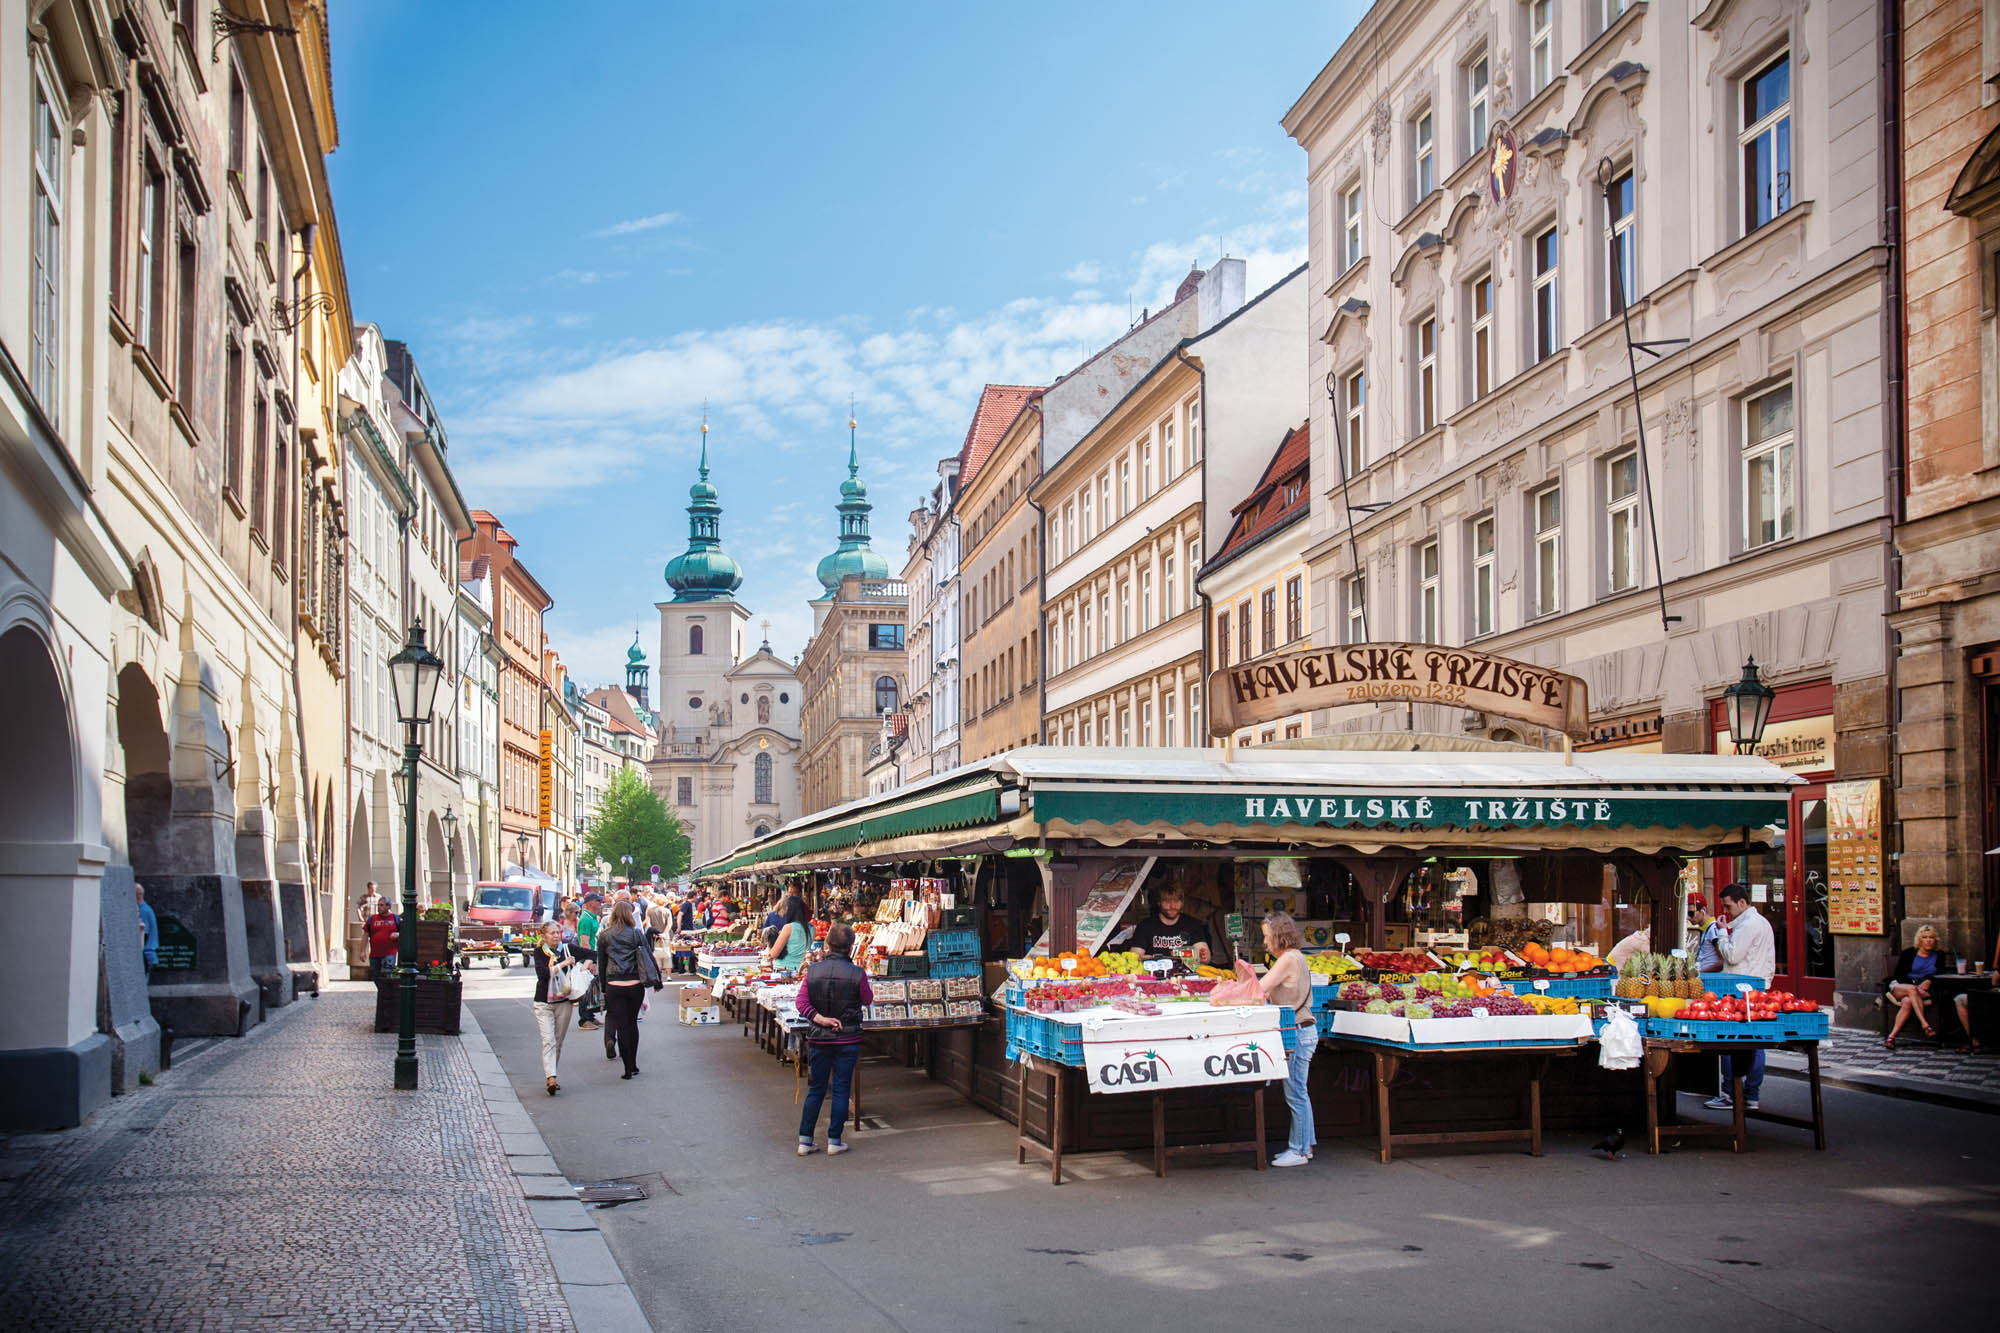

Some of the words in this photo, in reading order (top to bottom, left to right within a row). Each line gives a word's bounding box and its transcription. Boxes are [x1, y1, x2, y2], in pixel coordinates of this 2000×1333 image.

[1231, 646, 1417, 704] HAVELSKÉ
[1425, 651, 1564, 708] TRŽIŠTĚ
[1346, 683, 1422, 700] založeno
[1426, 683, 1466, 703] 1232
[1755, 737, 1789, 757] sushi
[1792, 735, 1825, 753] time
[541, 742, 550, 815] RESTAURANT
[1245, 797, 1433, 819] HAVELSKÉ
[1465, 797, 1612, 821] TRŽIŠTĚ
[1100, 1060, 1159, 1086] CASI
[1204, 1052, 1261, 1077] CASI
